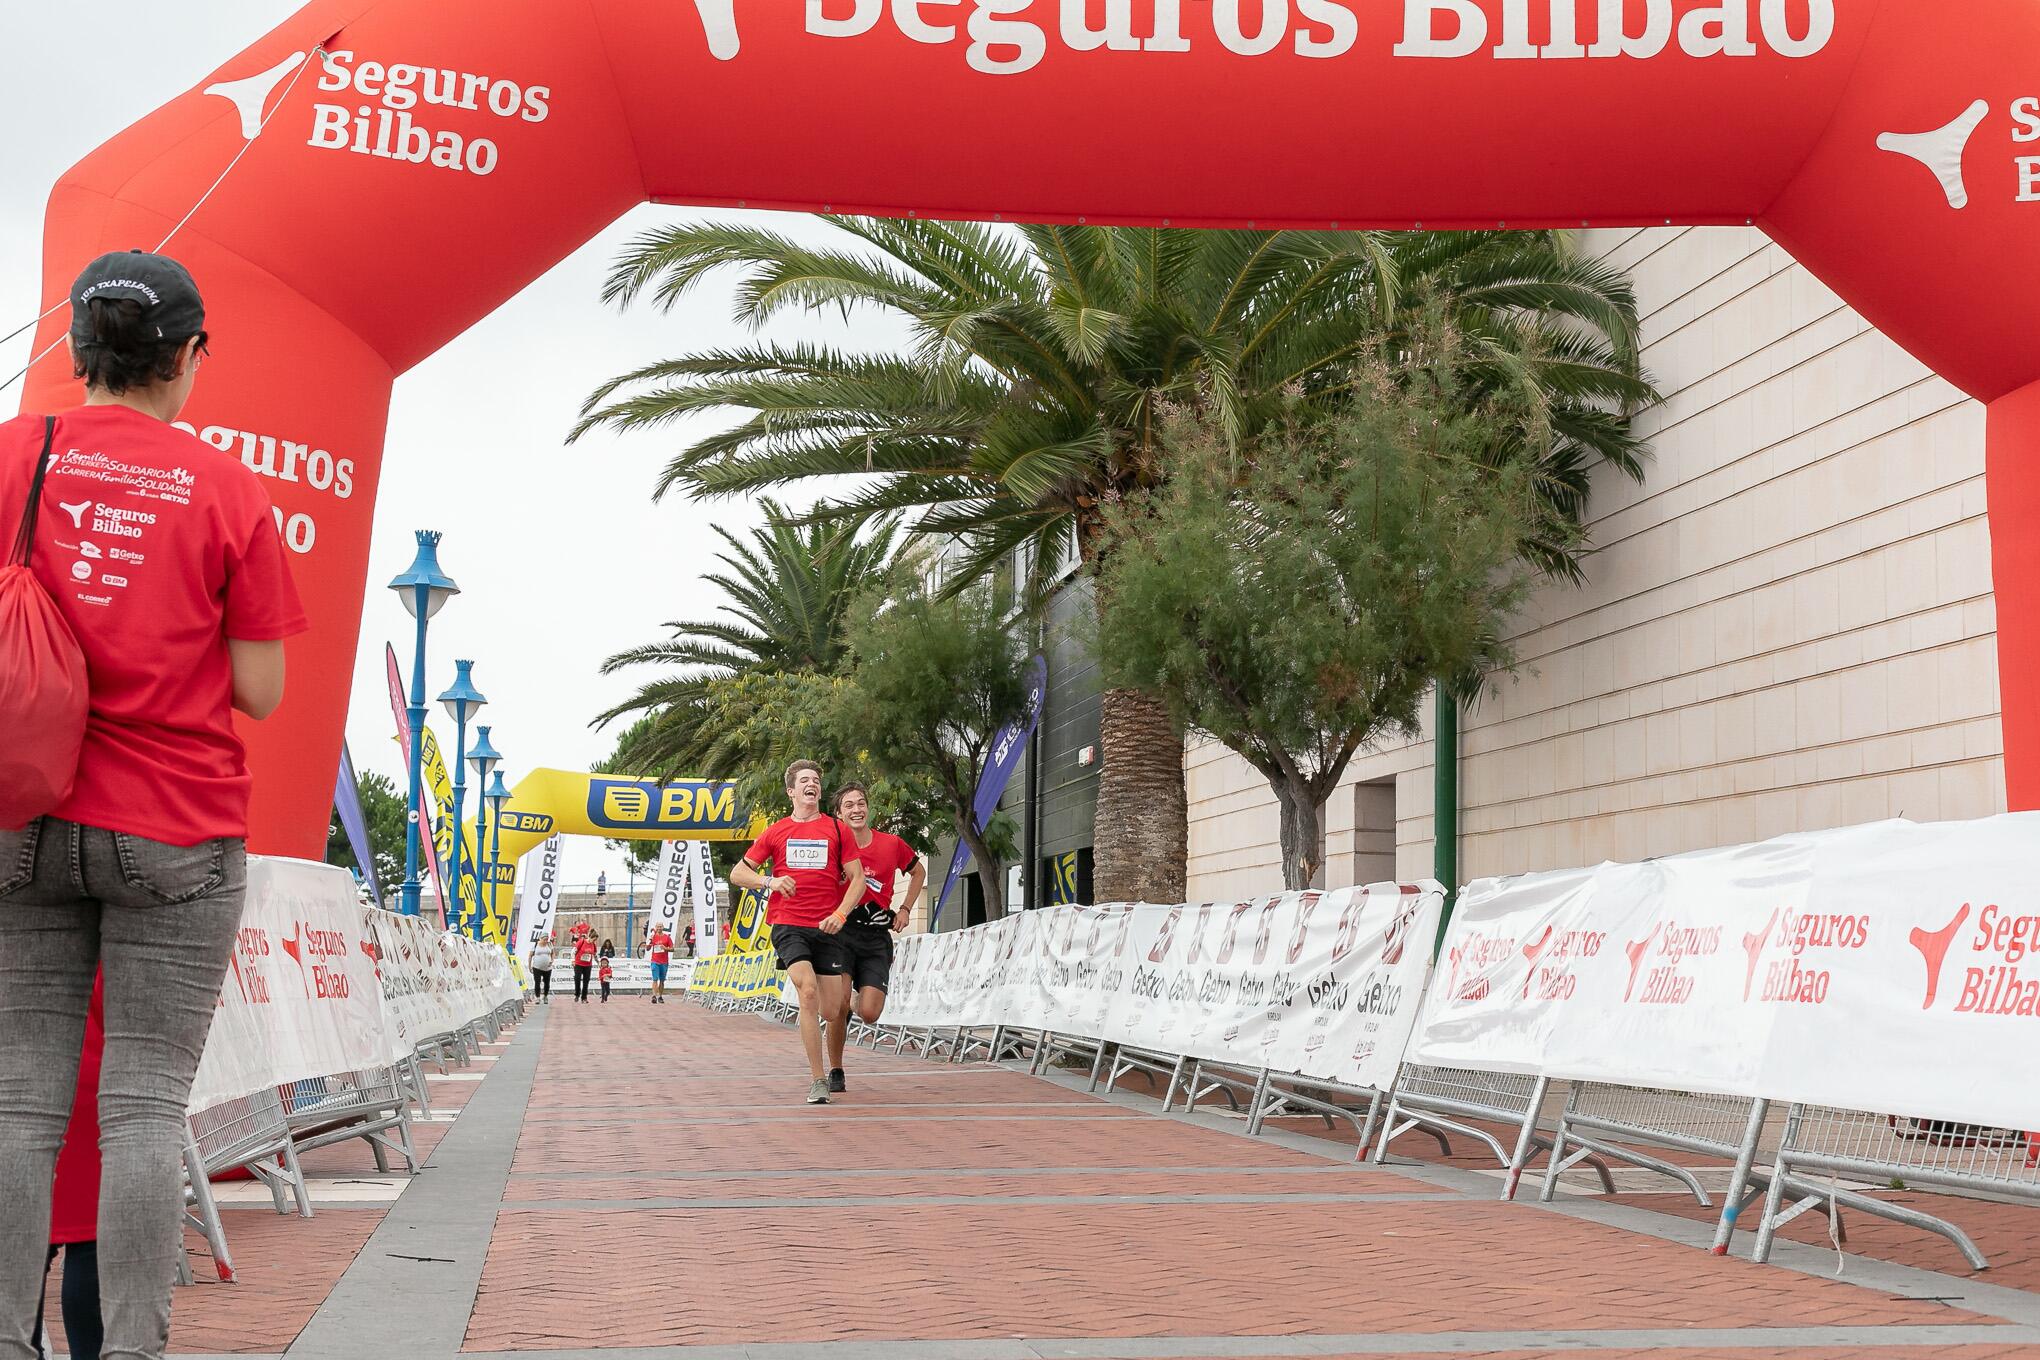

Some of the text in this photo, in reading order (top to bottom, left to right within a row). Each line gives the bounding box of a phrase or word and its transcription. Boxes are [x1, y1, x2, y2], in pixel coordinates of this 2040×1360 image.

[1393, 0, 1834, 59] Bilbao
[317, 50, 551, 123] Seguros
[307, 104, 499, 177] Bilbao
[80, 279, 160, 306] JUD TXAPELDUNA
[91, 518, 143, 538] Bilbao
[94, 502, 157, 525] Seguros
[119, 549, 145, 561] Getxo
[519, 815, 550, 832] BM
[658, 787, 735, 823] BM
[663, 839, 689, 918] CORREO
[700, 840, 715, 937] EL CORR
[1656, 920, 1724, 965] Seguros
[1777, 906, 1869, 956] Seguros
[1131, 963, 1165, 999] Getxo
[1199, 968, 1231, 1005] Getxo
[1307, 971, 1350, 1012] Getxo
[1357, 971, 1402, 1016] Getxo
[1640, 966, 1694, 1005] Bilbao
[1759, 958, 1830, 1004] Bilbao
